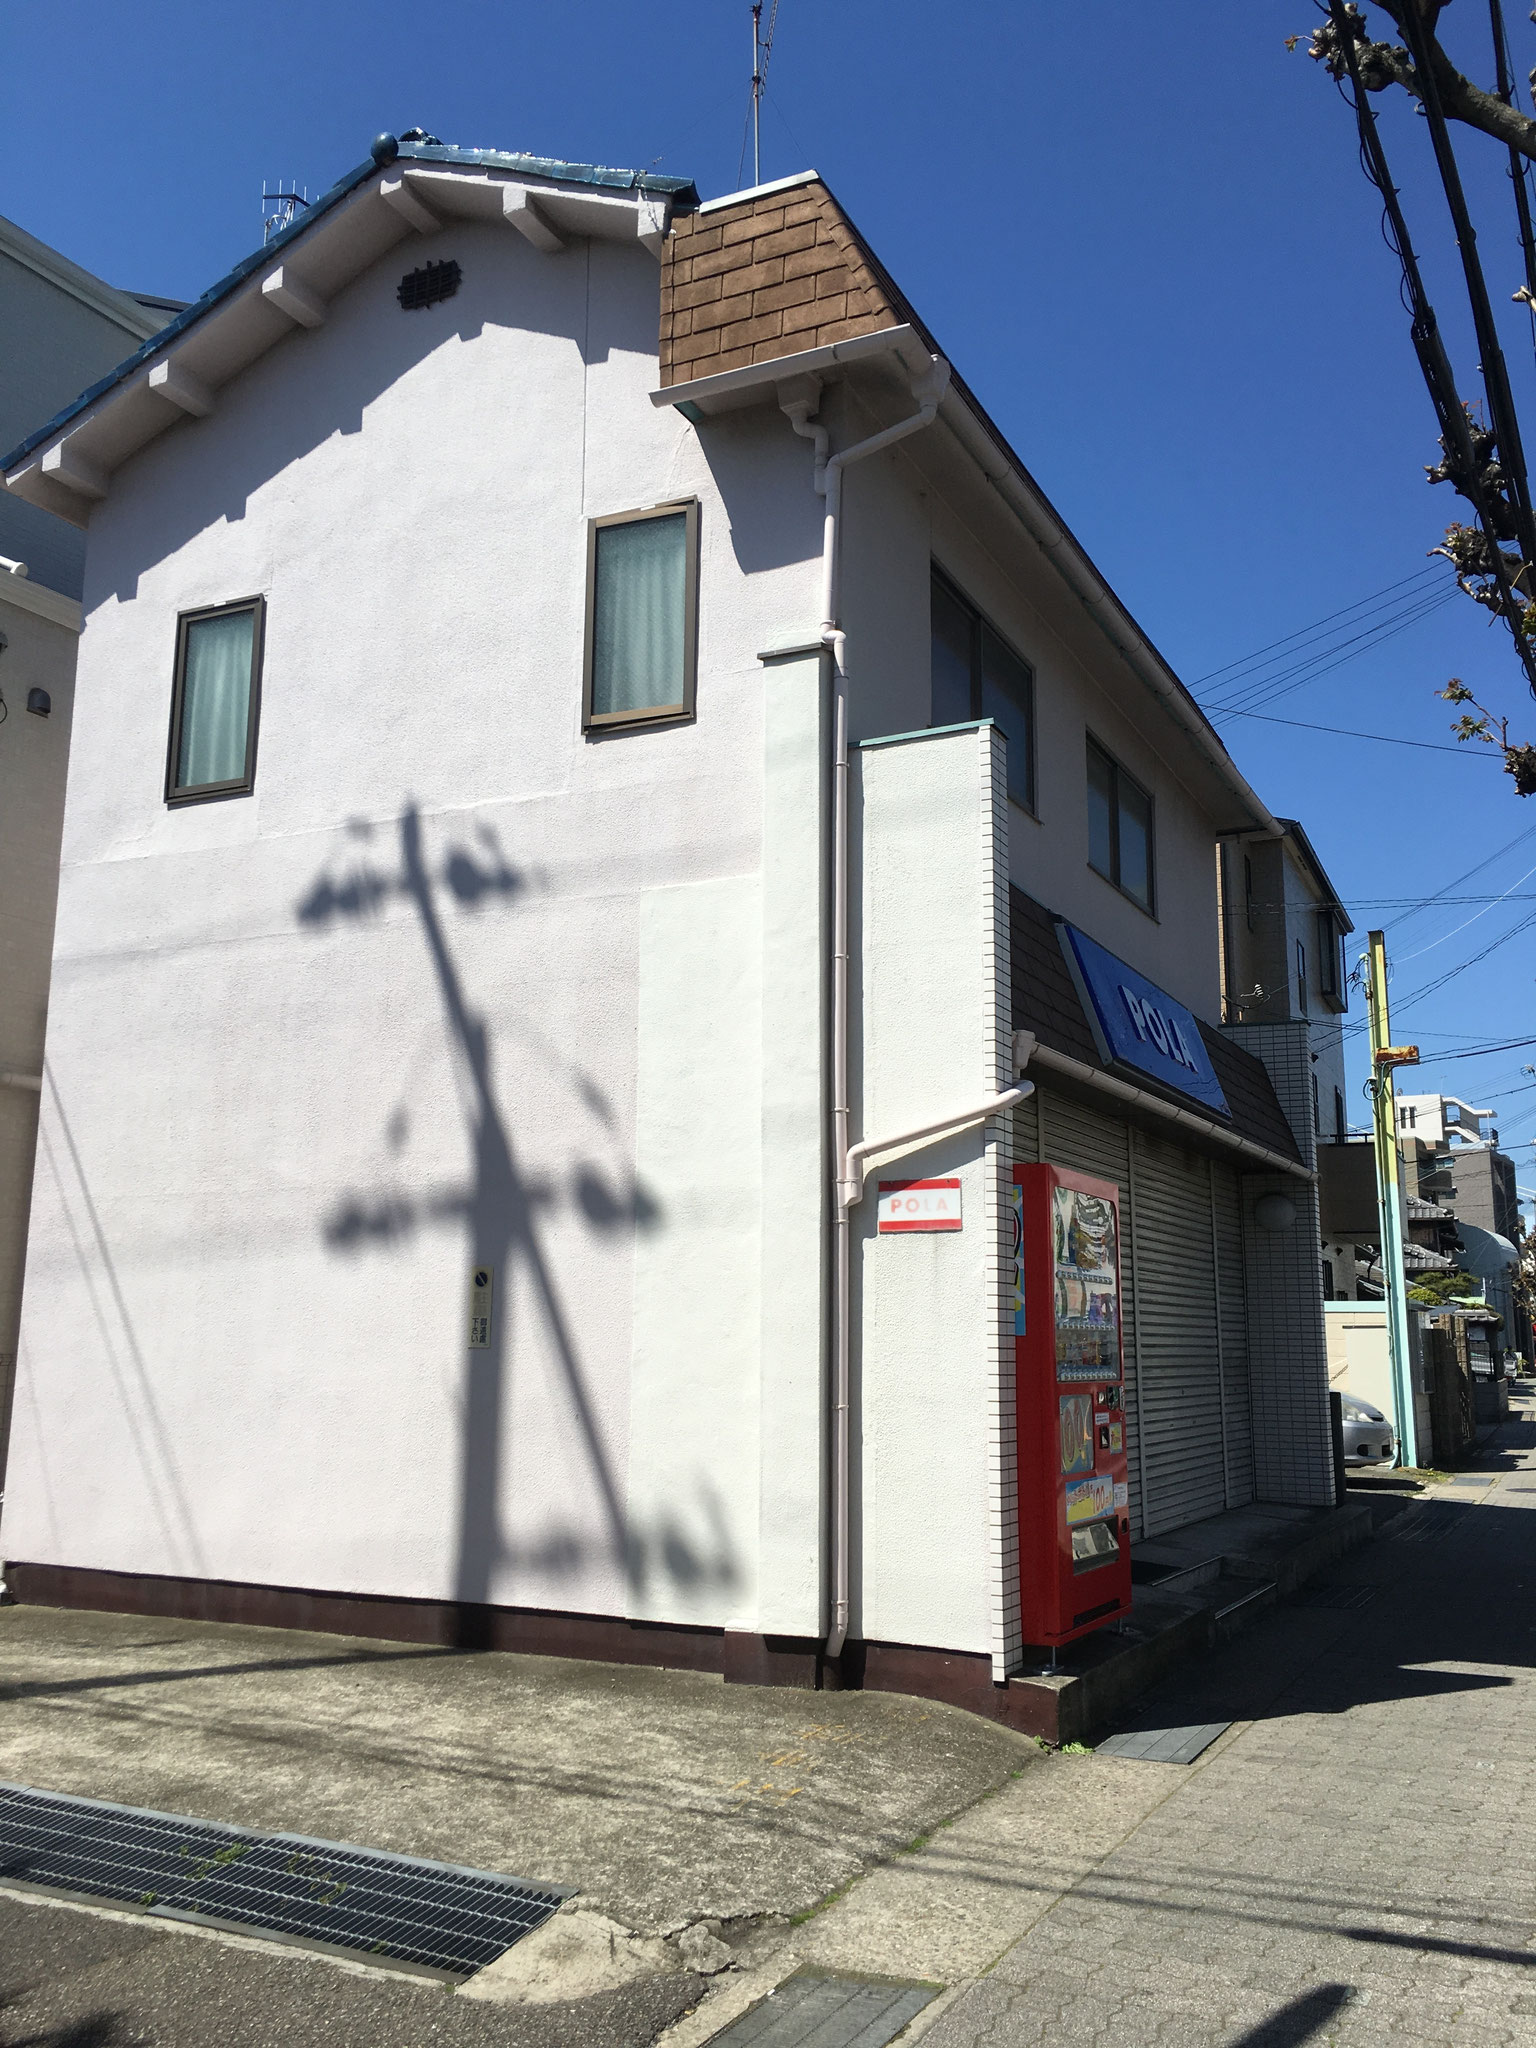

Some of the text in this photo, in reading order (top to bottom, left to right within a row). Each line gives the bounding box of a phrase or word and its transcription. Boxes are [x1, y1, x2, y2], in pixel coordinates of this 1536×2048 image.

[1118, 985, 1198, 1074] POLA
[890, 1197, 948, 1213] POLA
[471, 1317, 479, 1343] 下さい
